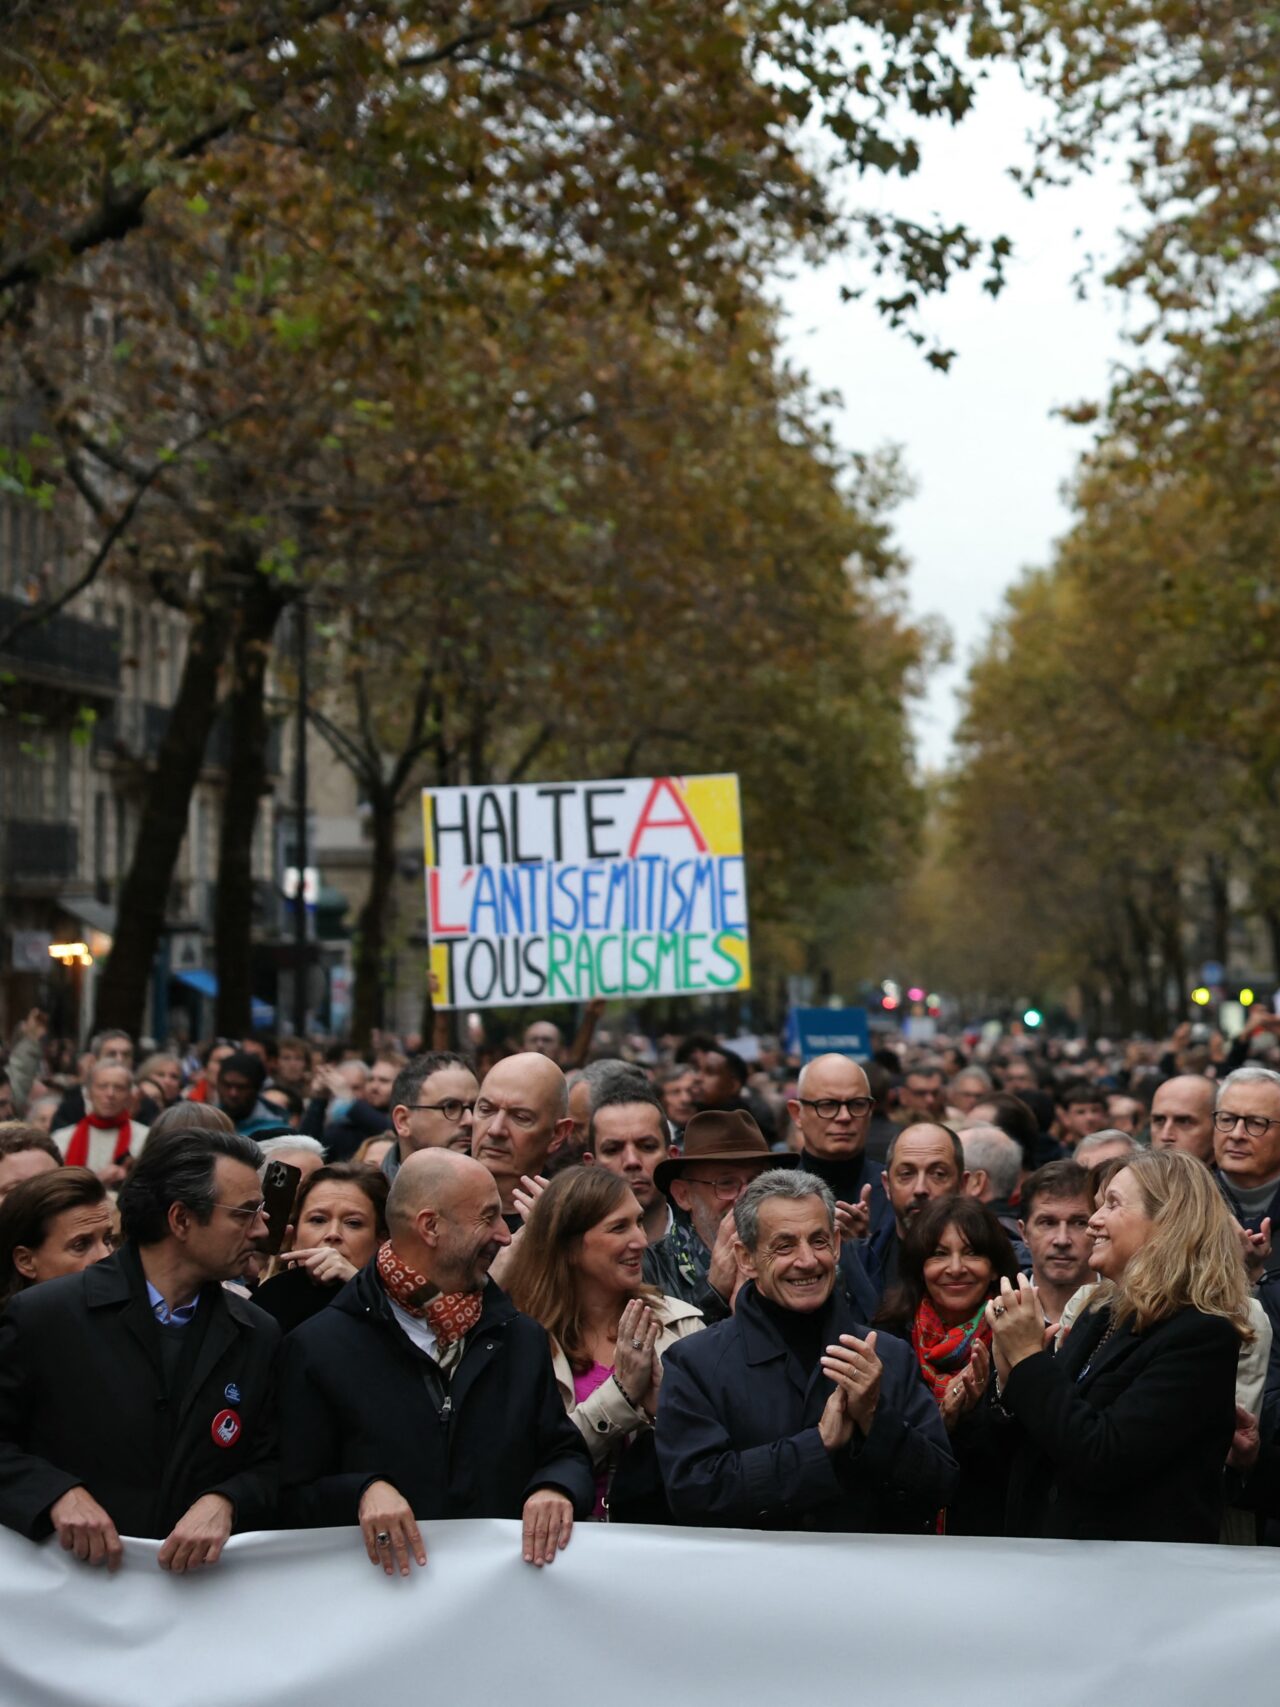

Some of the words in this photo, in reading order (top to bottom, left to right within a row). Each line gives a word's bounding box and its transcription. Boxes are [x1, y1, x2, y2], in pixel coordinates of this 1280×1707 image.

[432, 788, 626, 866] HALTE
[434, 937, 547, 1005] TOUS
[547, 926, 748, 997] RACISMES
